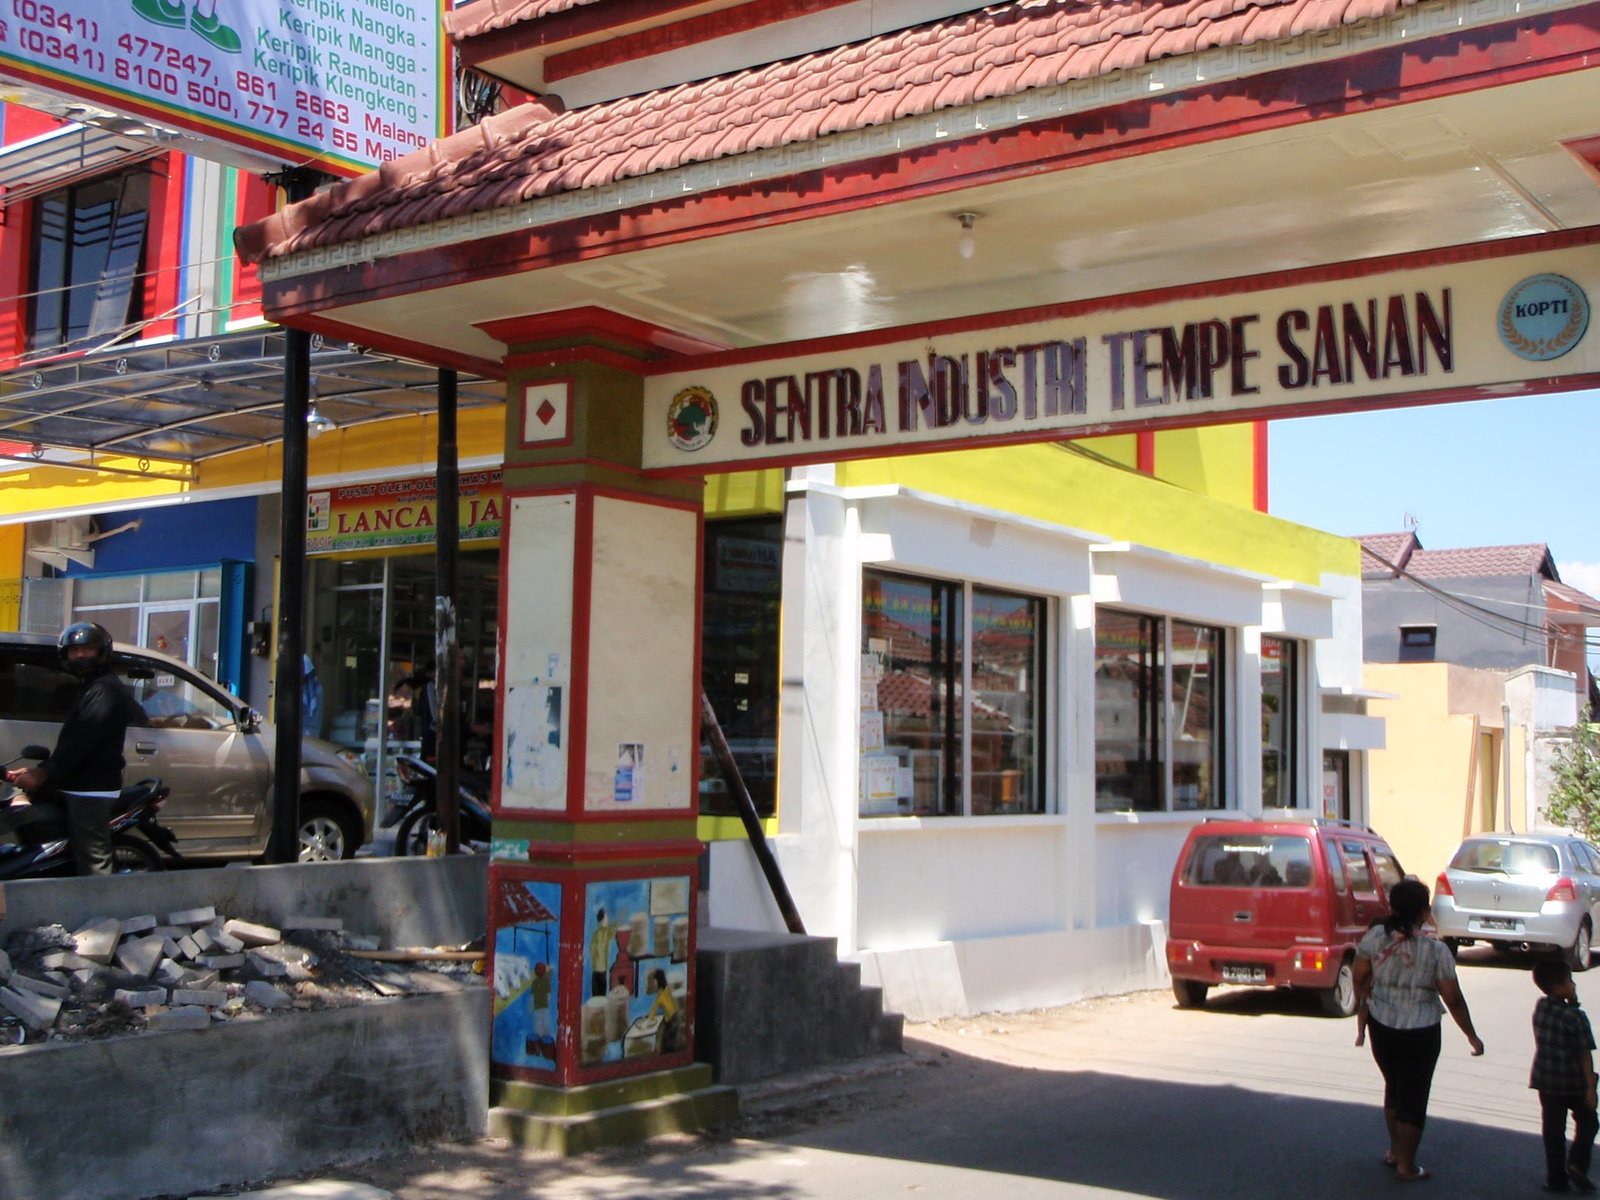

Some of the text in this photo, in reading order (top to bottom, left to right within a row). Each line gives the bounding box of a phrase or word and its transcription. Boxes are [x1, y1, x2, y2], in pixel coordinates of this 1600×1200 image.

[279, 8, 343, 49] Keripik
[349, 33, 417, 74] Mangga
[290, 0, 346, 23] eripik
[351, 7, 416, 48] Nangka
[13, 0, 98, 42] (0341)
[118, 33, 219, 86] 477247,
[237, 70, 277, 101] 861
[296, 90, 350, 124] 2663
[19, 27, 104, 72] (0341)
[115, 58, 178, 96] 8100
[187, 81, 239, 119] 500,
[248, 99, 290, 130] 777
[297, 116, 325, 141] 24
[332, 127, 358, 153] 55
[254, 48, 320, 88] Keripik
[325, 72, 417, 125] Klengkeng
[257, 27, 323, 67] Keripik
[329, 52, 416, 99] Rambutan
[1515, 299, 1568, 318] KOPTI
[740, 286, 1455, 448] SENTRA INDUSTRI TEMPE SANAN
[337, 505, 434, 535] LANCA
[338, 486, 377, 500] PUSAT
[380, 480, 438, 496] OLEH-OLE
[459, 472, 488, 485] HAS
